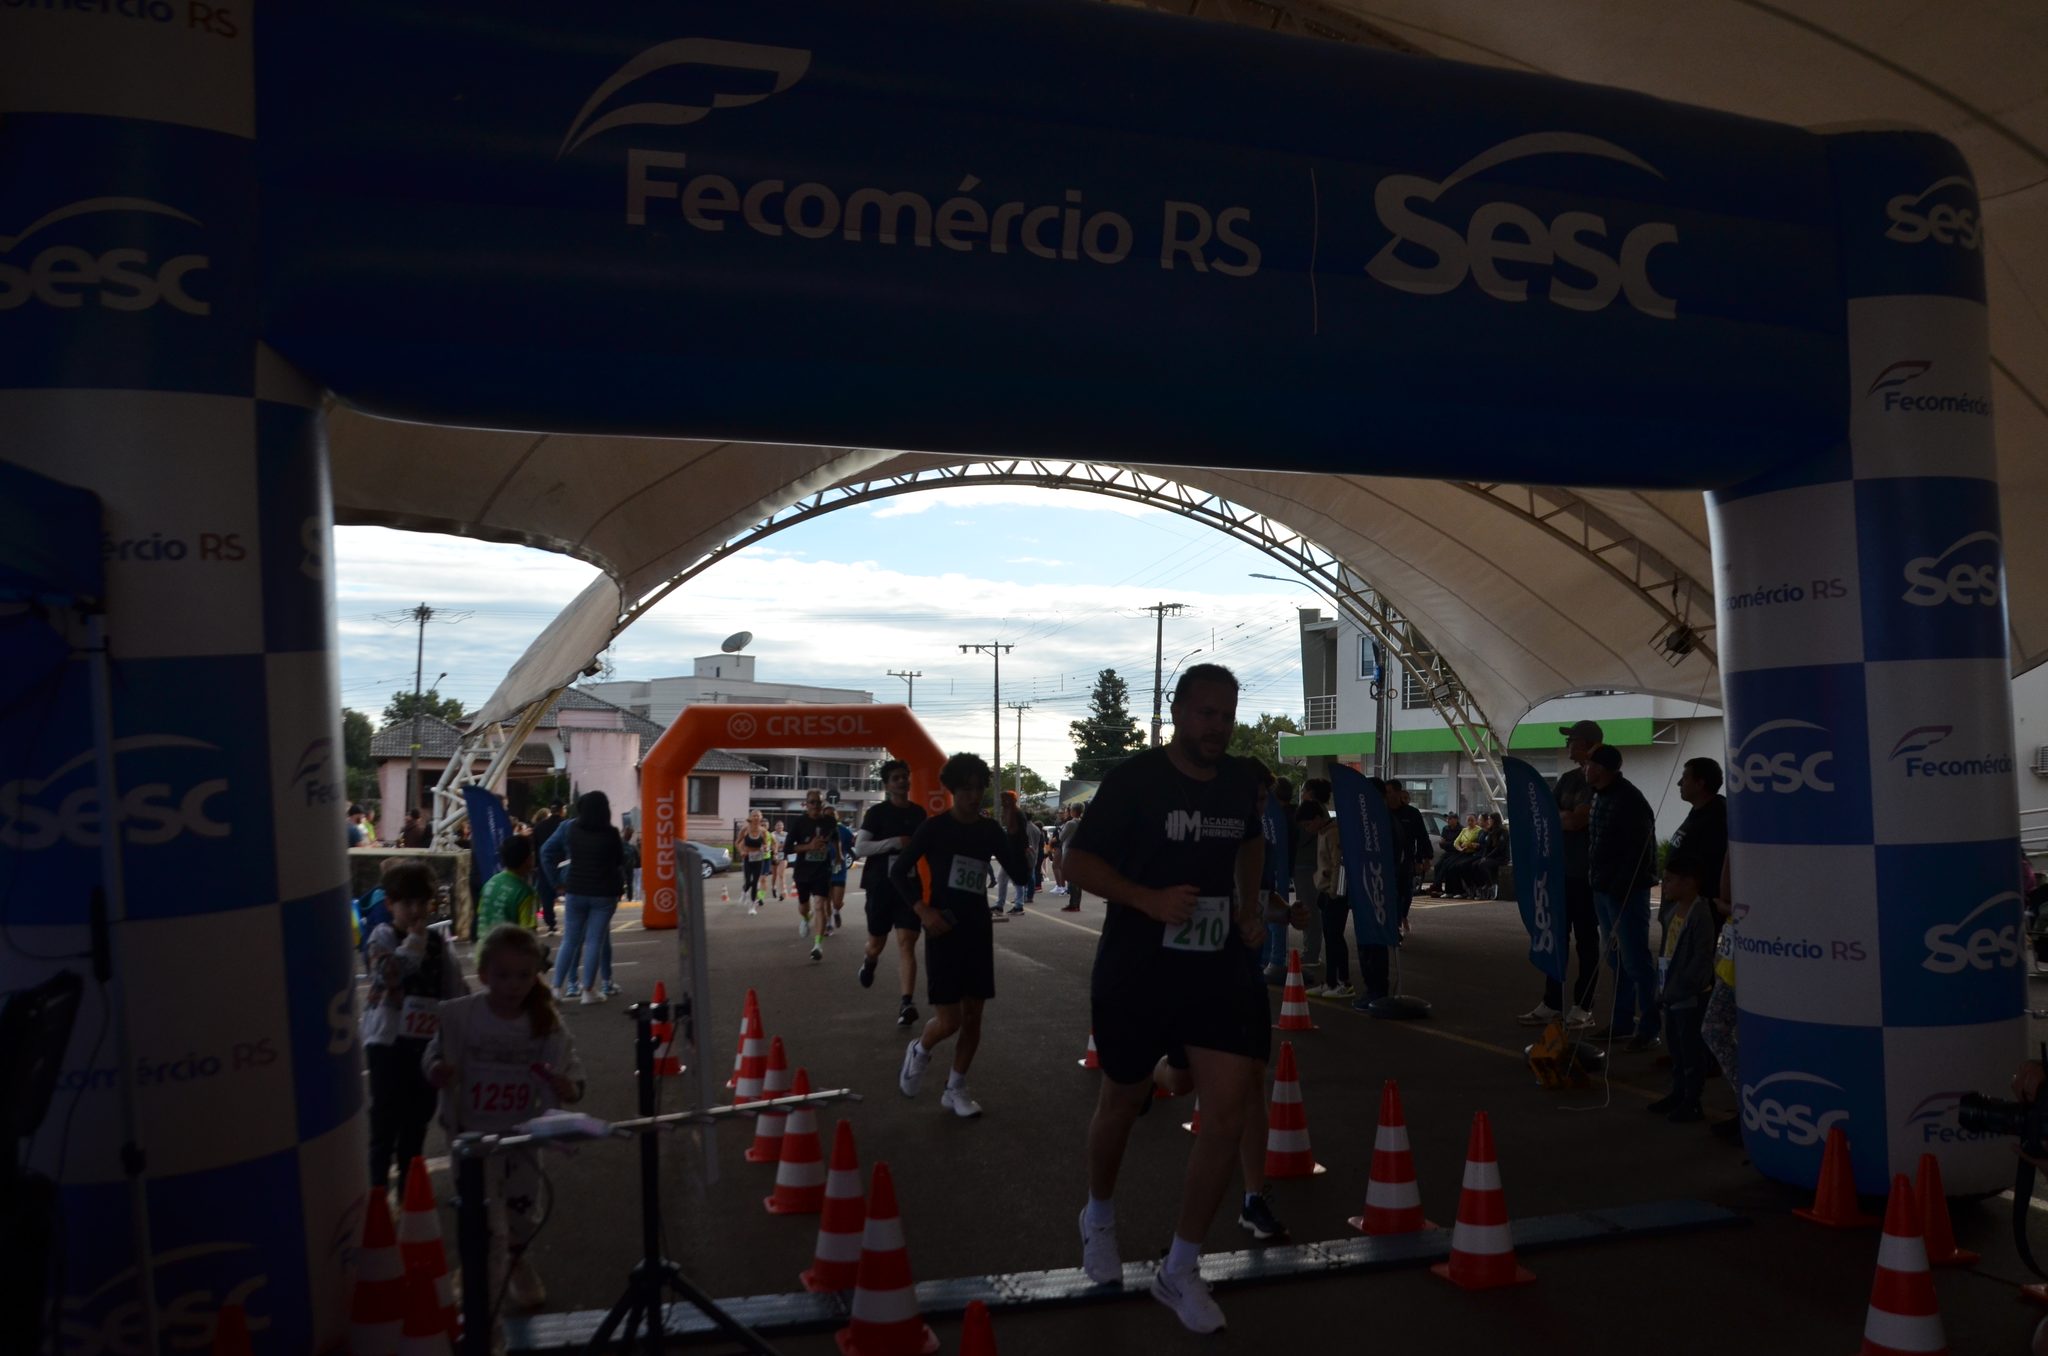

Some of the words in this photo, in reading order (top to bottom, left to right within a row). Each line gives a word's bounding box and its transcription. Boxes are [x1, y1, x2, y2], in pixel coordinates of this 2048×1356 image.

[188, 1, 238, 38] RS
[626, 147, 1133, 265] Fecomércio
[1160, 200, 1263, 278] RS
[1363, 174, 1680, 320] Sesc
[200, 533, 246, 561] RS
[1811, 578, 1848, 601] RS
[766, 714, 872, 737] CRESOL
[656, 789, 675, 882] CRESOL
[1172, 906, 1224, 946] 210
[1831, 940, 1867, 962] RS
[232, 1037, 279, 1072] RS
[471, 1081, 530, 1111] 1259
